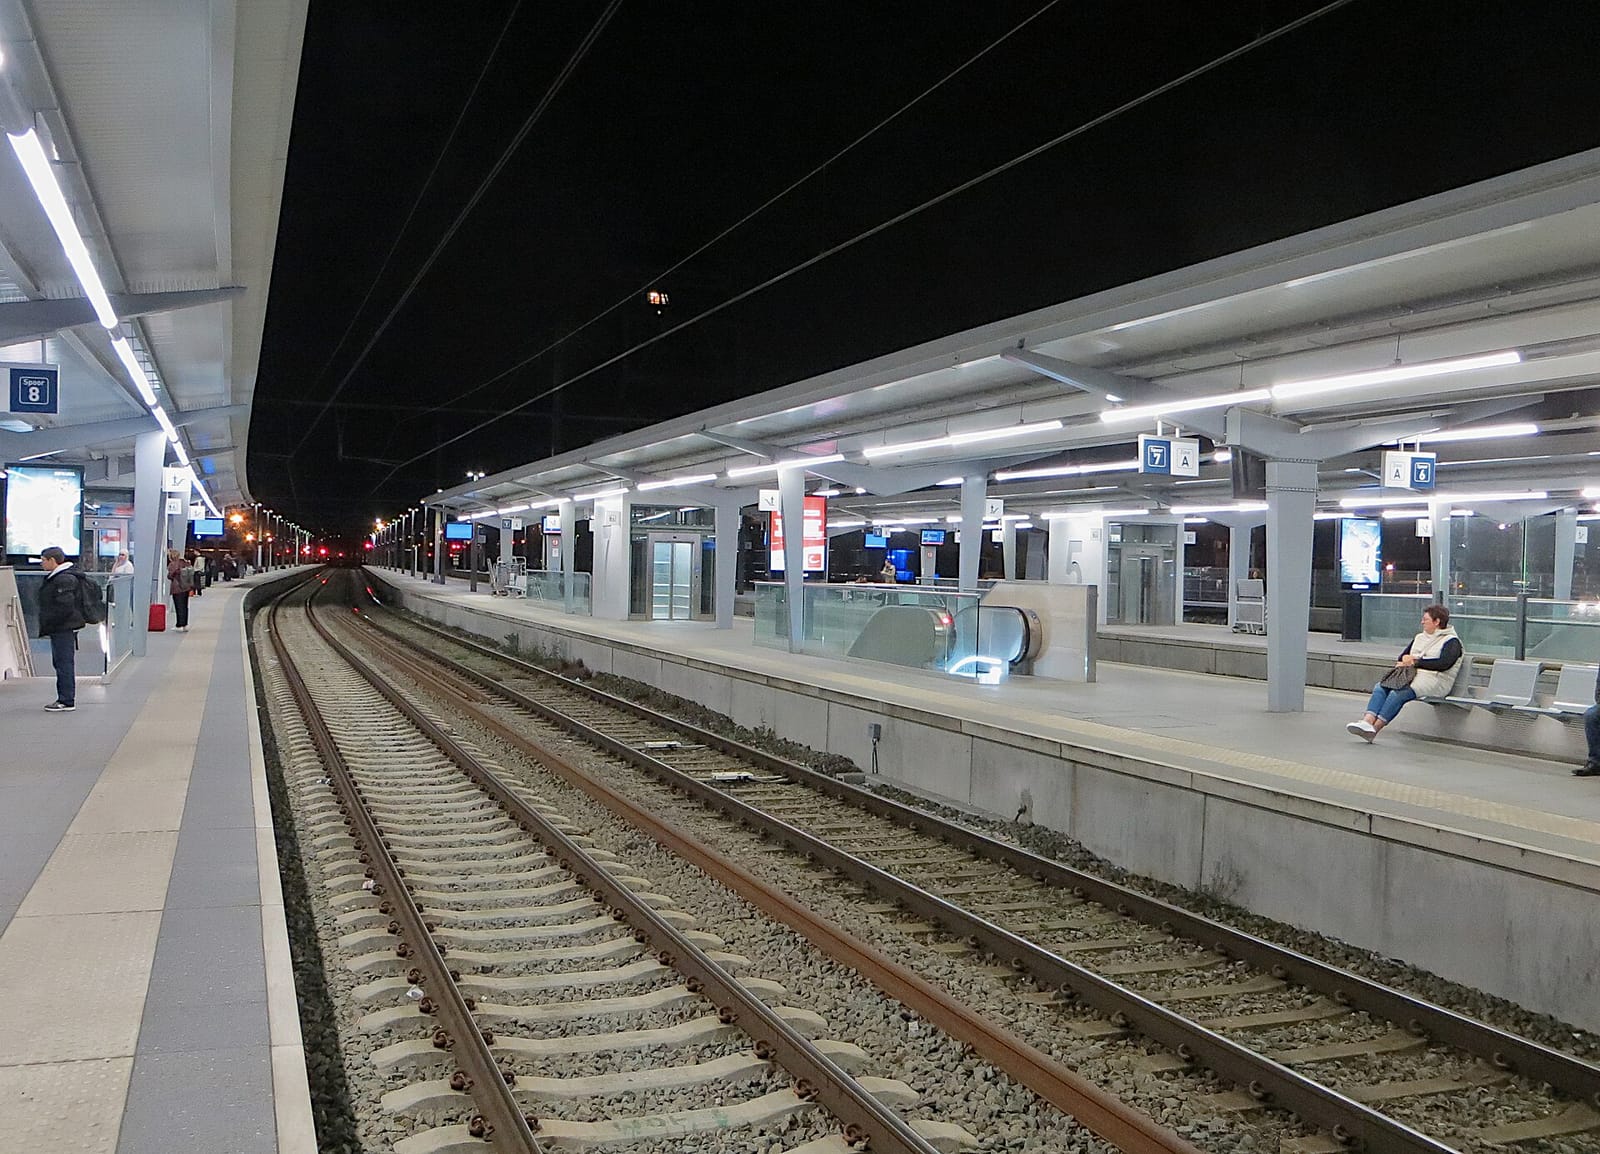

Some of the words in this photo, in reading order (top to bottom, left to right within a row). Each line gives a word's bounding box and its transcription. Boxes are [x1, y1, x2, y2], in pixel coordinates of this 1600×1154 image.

[28, 387, 40, 402] 8
[1153, 453, 1161, 465] 7
[1181, 455, 1189, 466] A
[1393, 469, 1400, 479] A
[1419, 469, 1425, 480] 6
